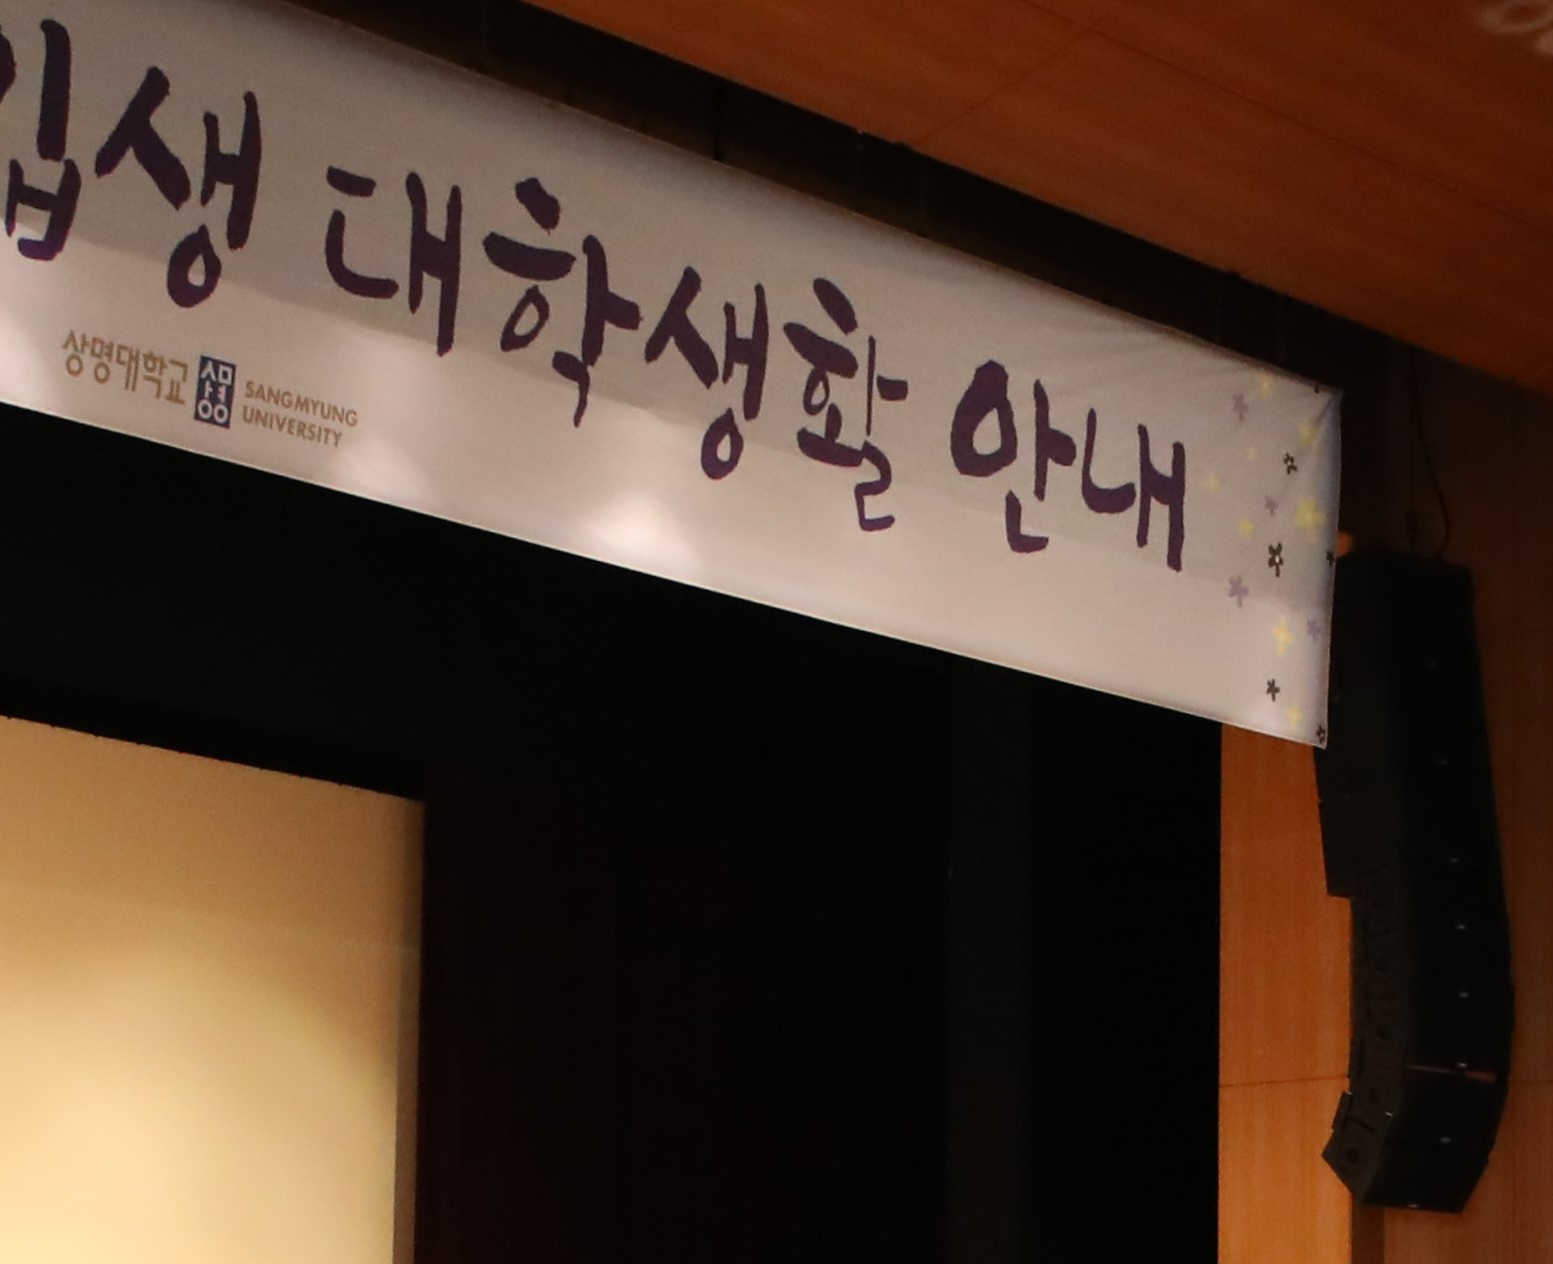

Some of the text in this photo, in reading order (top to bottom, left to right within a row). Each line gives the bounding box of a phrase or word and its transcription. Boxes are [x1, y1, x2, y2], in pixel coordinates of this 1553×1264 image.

[62, 328, 189, 407] 상명대학교
[323, 166, 908, 532] 대학생활
[950, 359, 1186, 573] 안내
[242, 404, 343, 448] UNIVERSITY
[244, 380, 360, 428] SANGMYUNG
